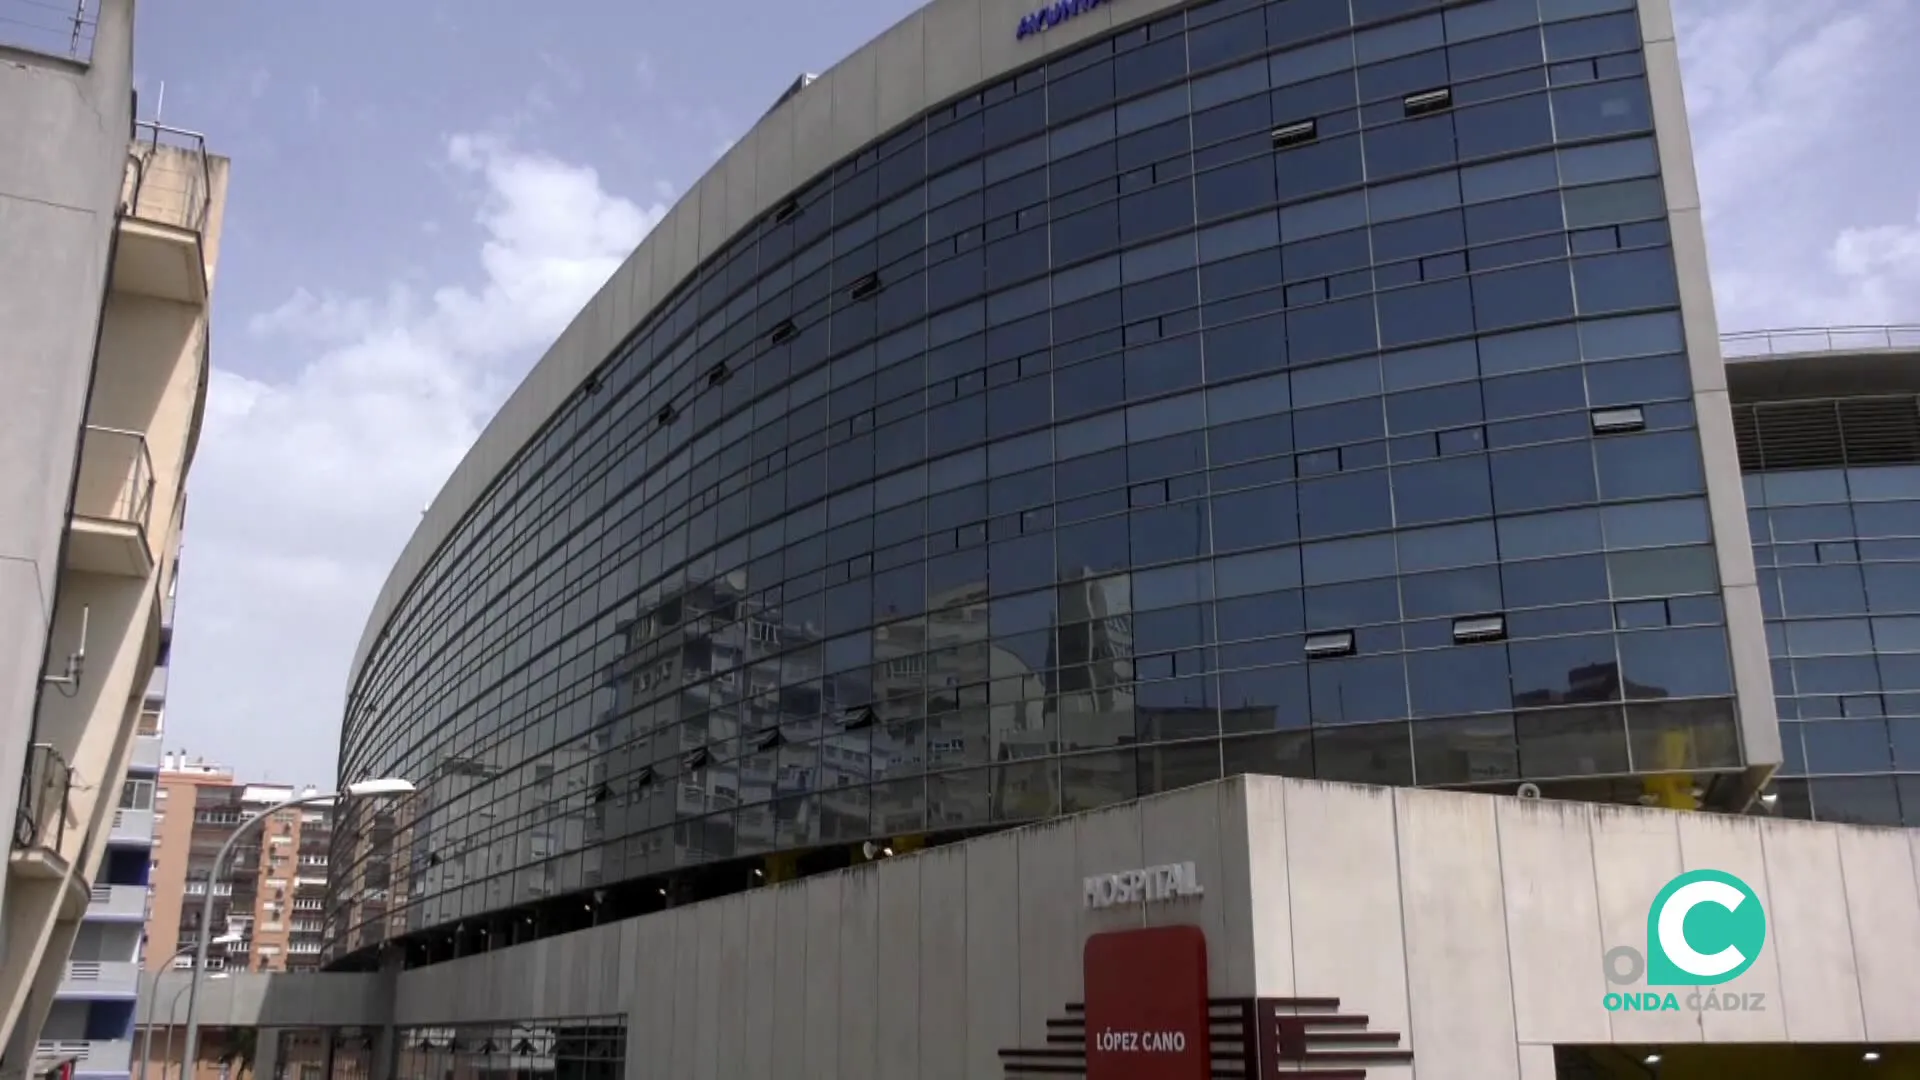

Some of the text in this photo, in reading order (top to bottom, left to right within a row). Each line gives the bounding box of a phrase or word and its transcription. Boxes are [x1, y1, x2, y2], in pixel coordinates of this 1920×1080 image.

[1083, 861, 1204, 909] HOSPITAL
[1096, 1026, 1186, 1052] LÓPEZ CANO
